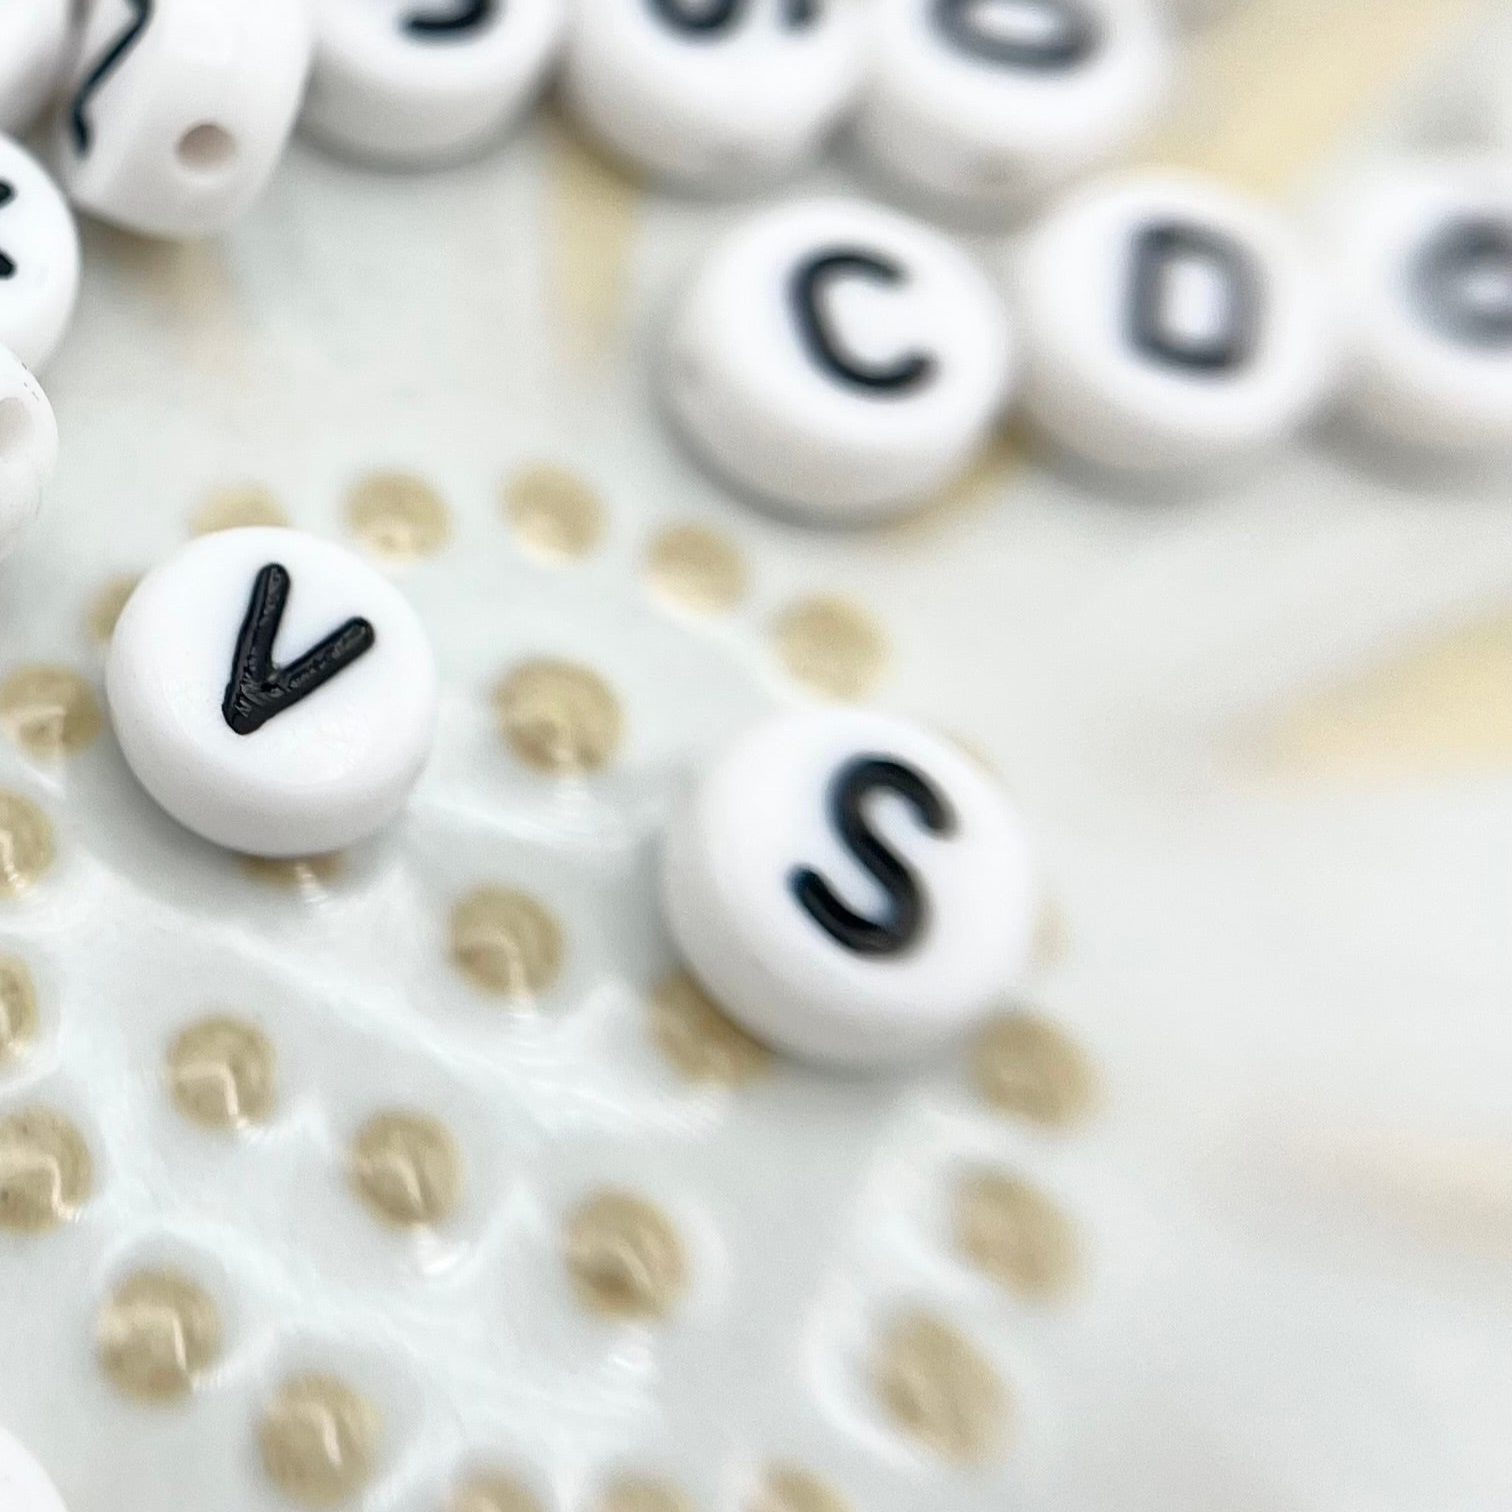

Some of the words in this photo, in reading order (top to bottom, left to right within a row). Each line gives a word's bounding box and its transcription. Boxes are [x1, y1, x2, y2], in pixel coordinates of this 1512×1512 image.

[786, 245, 936, 400] C
[221, 563, 375, 735] V
[788, 754, 952, 958] S
